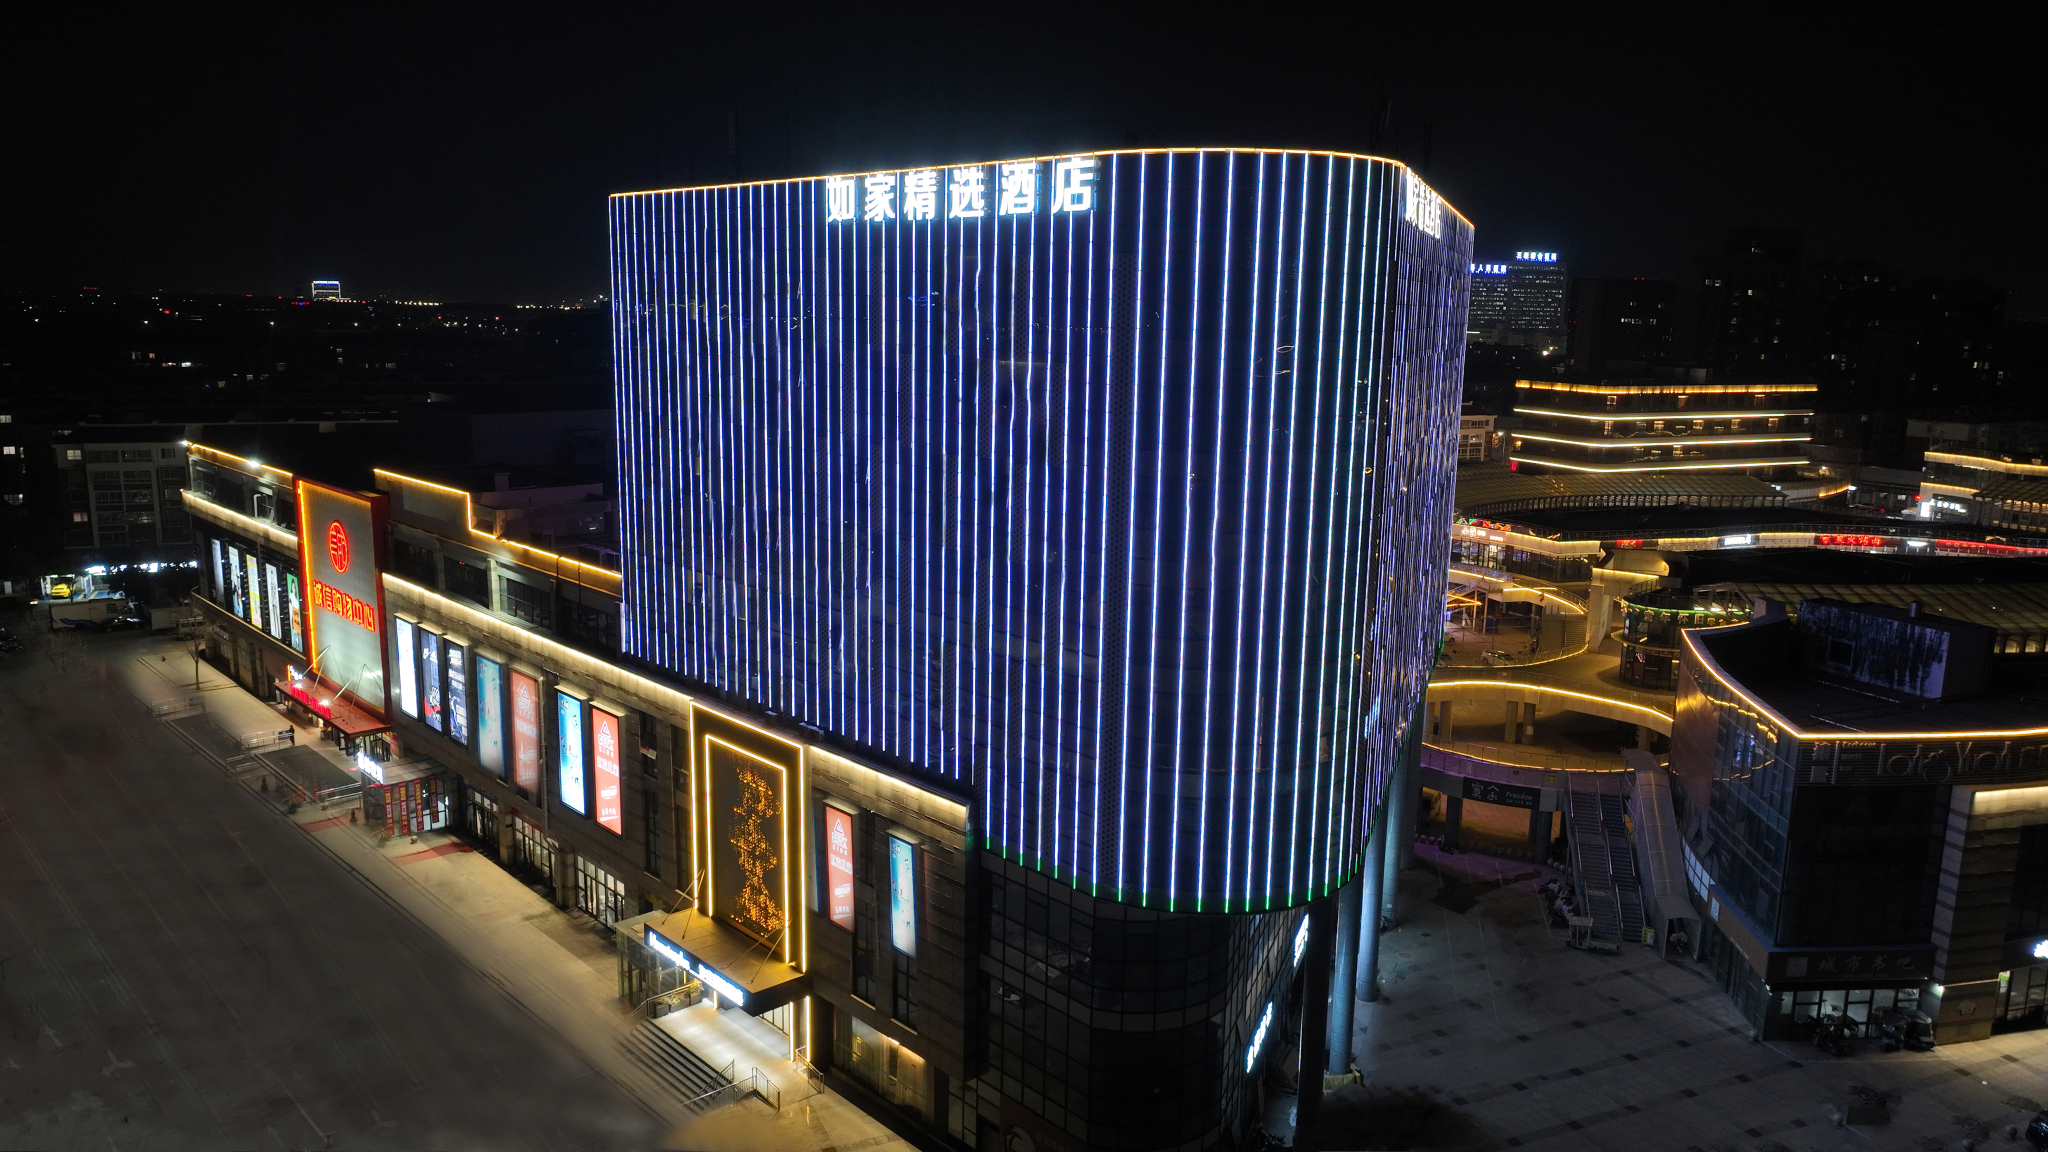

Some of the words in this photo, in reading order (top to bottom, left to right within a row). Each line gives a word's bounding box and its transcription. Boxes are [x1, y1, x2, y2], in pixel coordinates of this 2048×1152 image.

[826, 156, 1096, 223] 如家精选酒店
[312, 579, 376, 634] 诚信购物中心
[1818, 954, 1914, 974] 城市书吧
